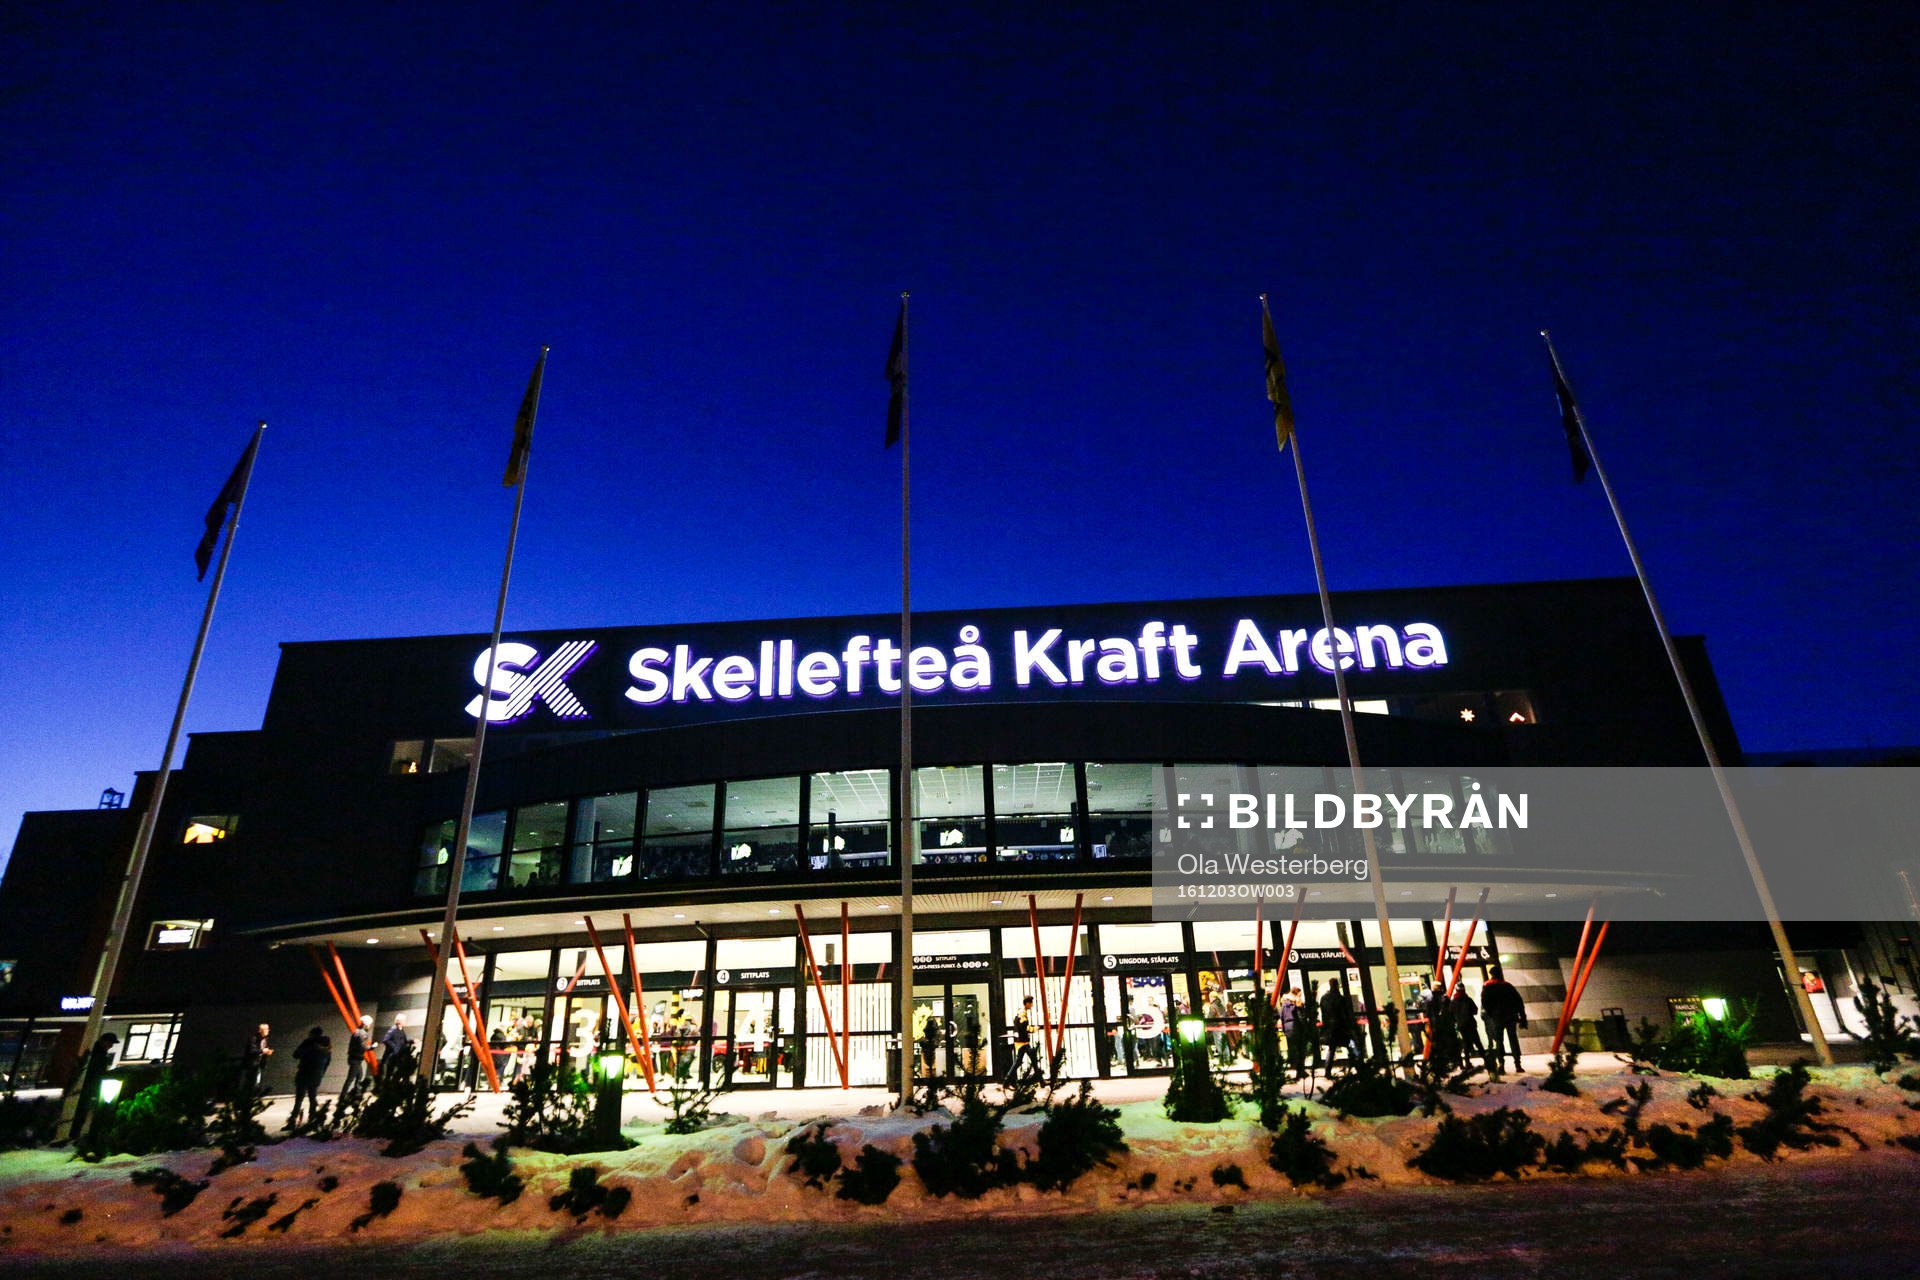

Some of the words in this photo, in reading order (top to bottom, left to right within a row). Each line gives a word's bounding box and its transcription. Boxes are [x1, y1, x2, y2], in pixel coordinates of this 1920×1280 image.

[624, 625, 992, 704] Skellefteå
[1013, 621, 1201, 686] Kraft
[1222, 619, 1449, 676] Arena
[1119, 957, 1149, 965] UNGDOM,
[1150, 955, 1179, 964] STÅPLATS
[740, 971, 770, 979] SITTPLATS
